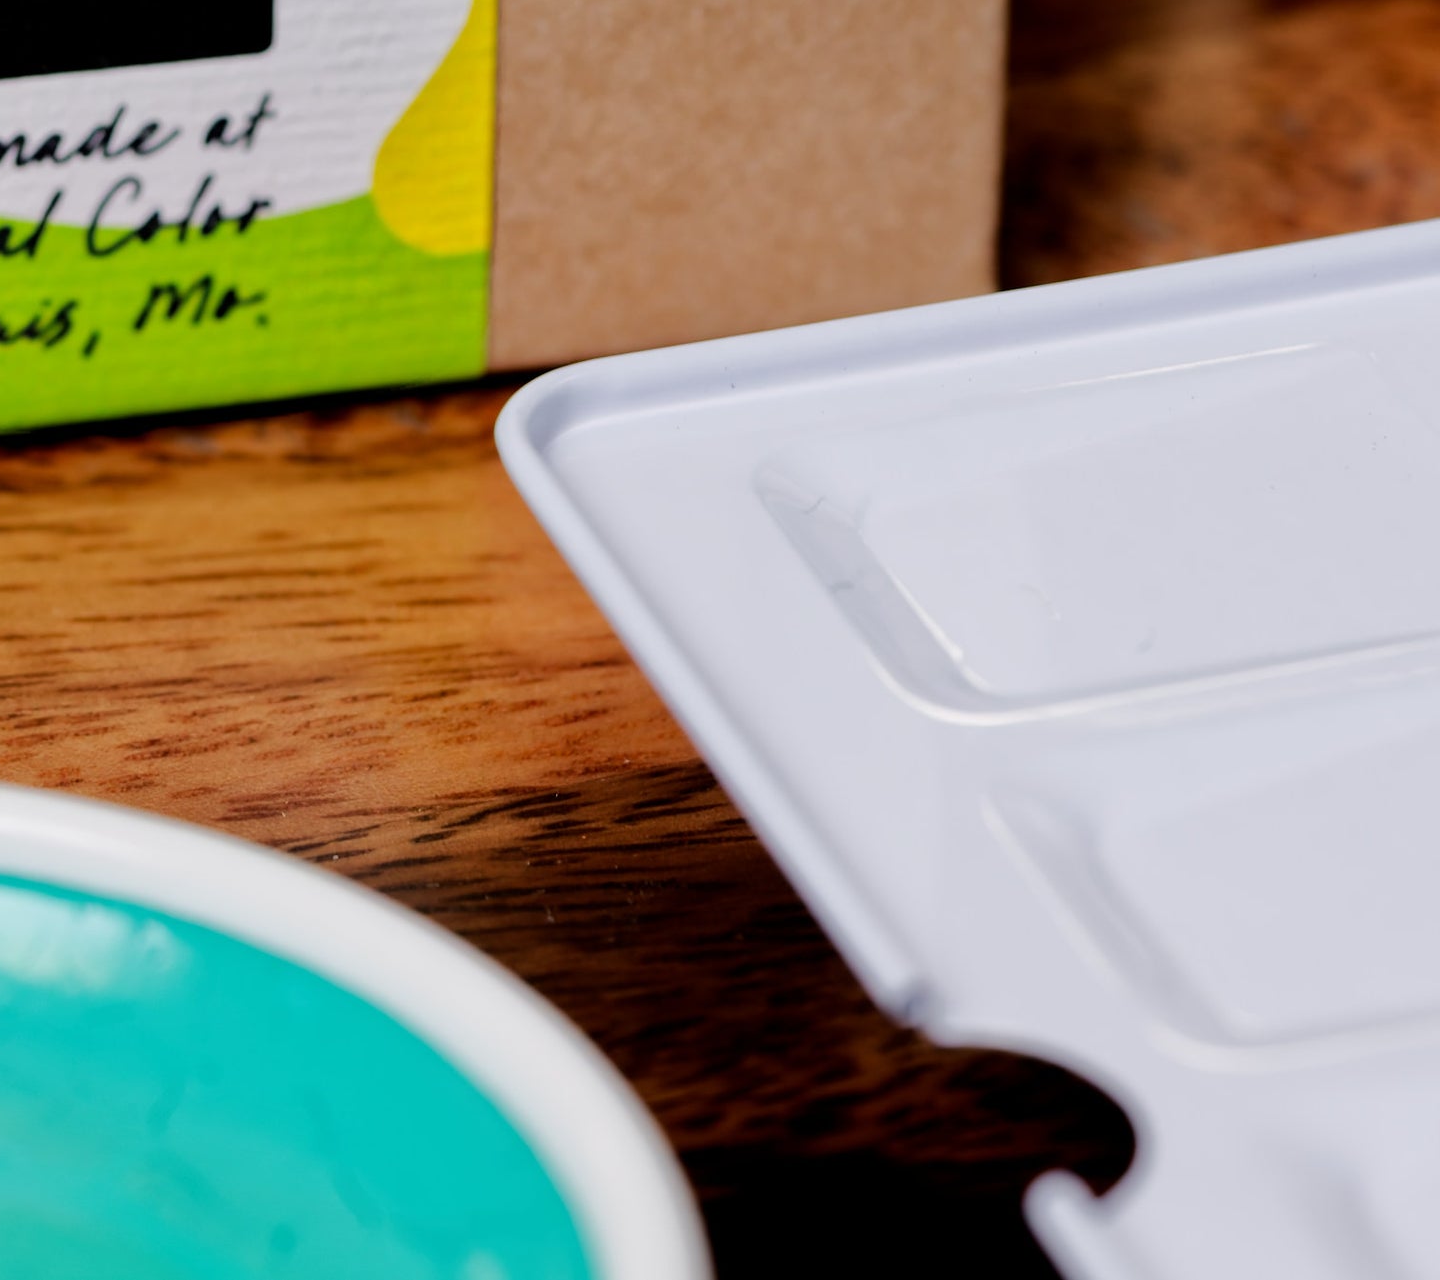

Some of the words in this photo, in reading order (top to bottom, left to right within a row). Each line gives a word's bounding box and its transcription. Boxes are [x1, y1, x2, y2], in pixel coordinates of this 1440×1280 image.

[204, 90, 276, 149] at
[85, 174, 272, 258] Color
[131, 273, 268, 333] Mo.
